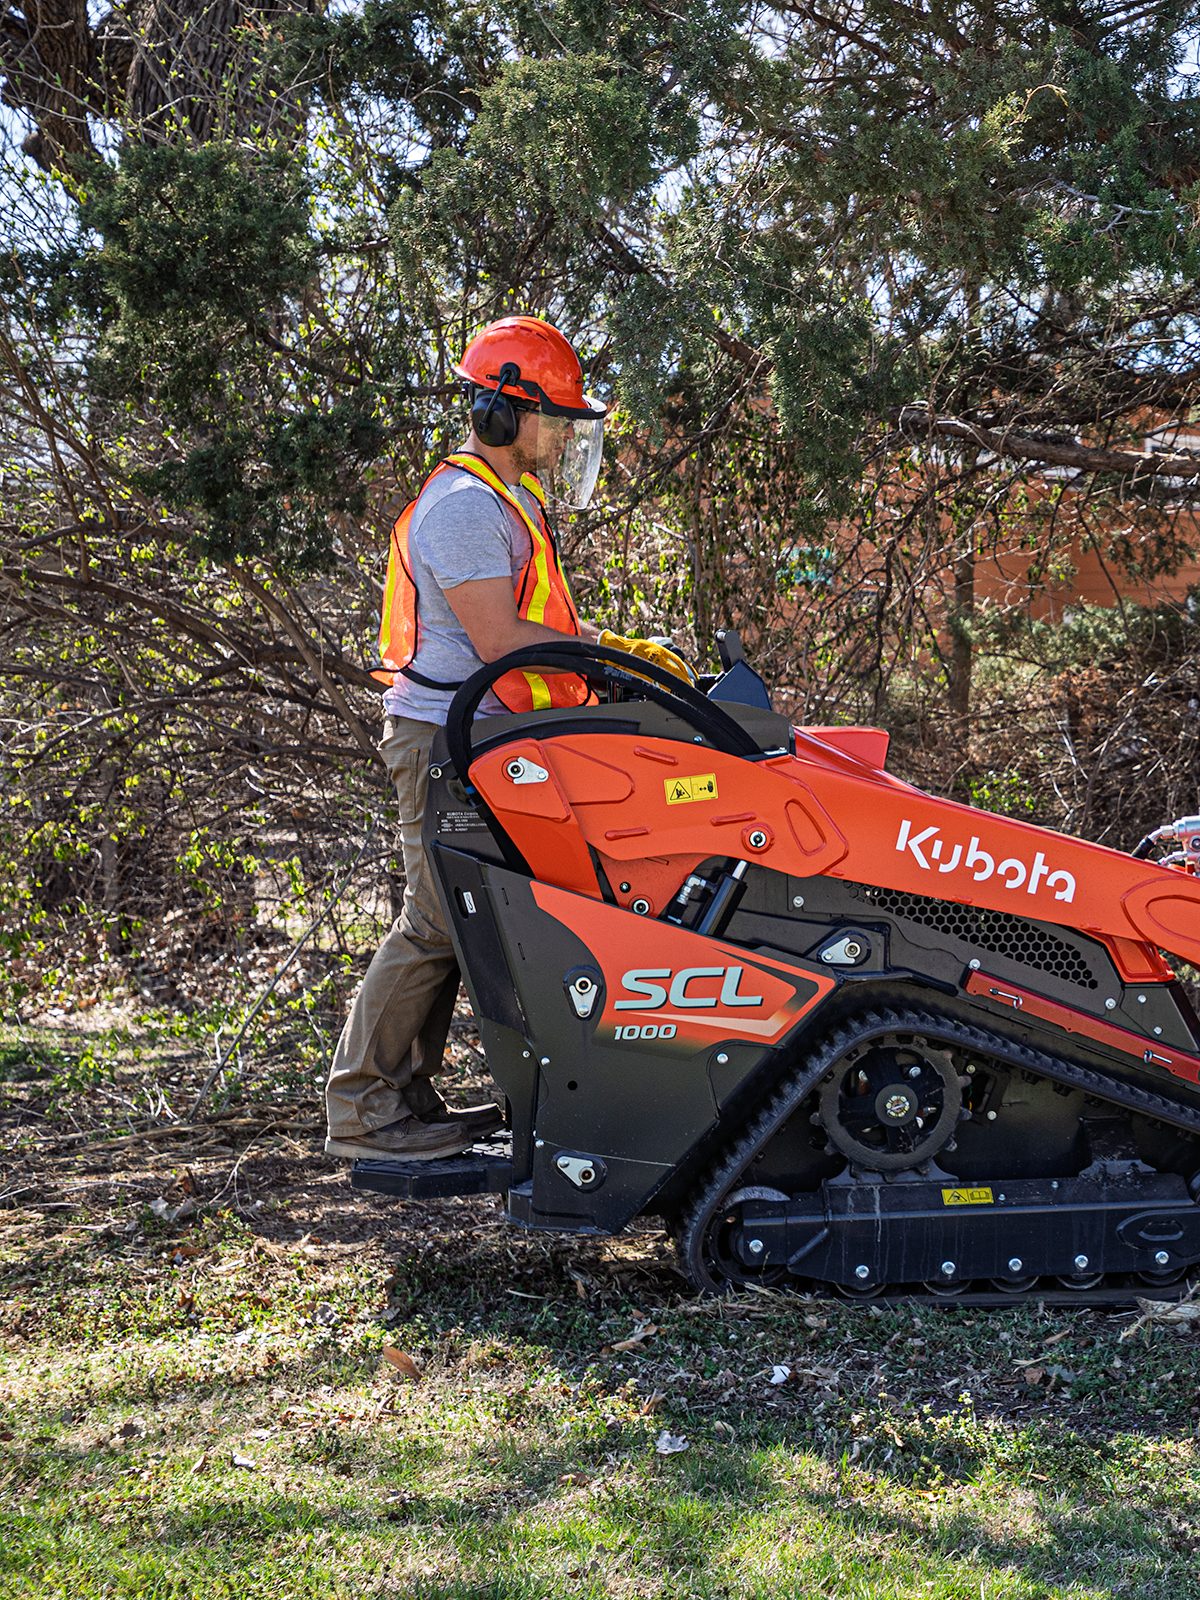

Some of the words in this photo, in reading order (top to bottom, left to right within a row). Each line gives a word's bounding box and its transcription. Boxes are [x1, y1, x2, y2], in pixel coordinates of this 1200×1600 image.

[895, 819, 1076, 903] Kubota
[614, 966, 763, 1010] SCL
[614, 1024, 677, 1041] 1000
